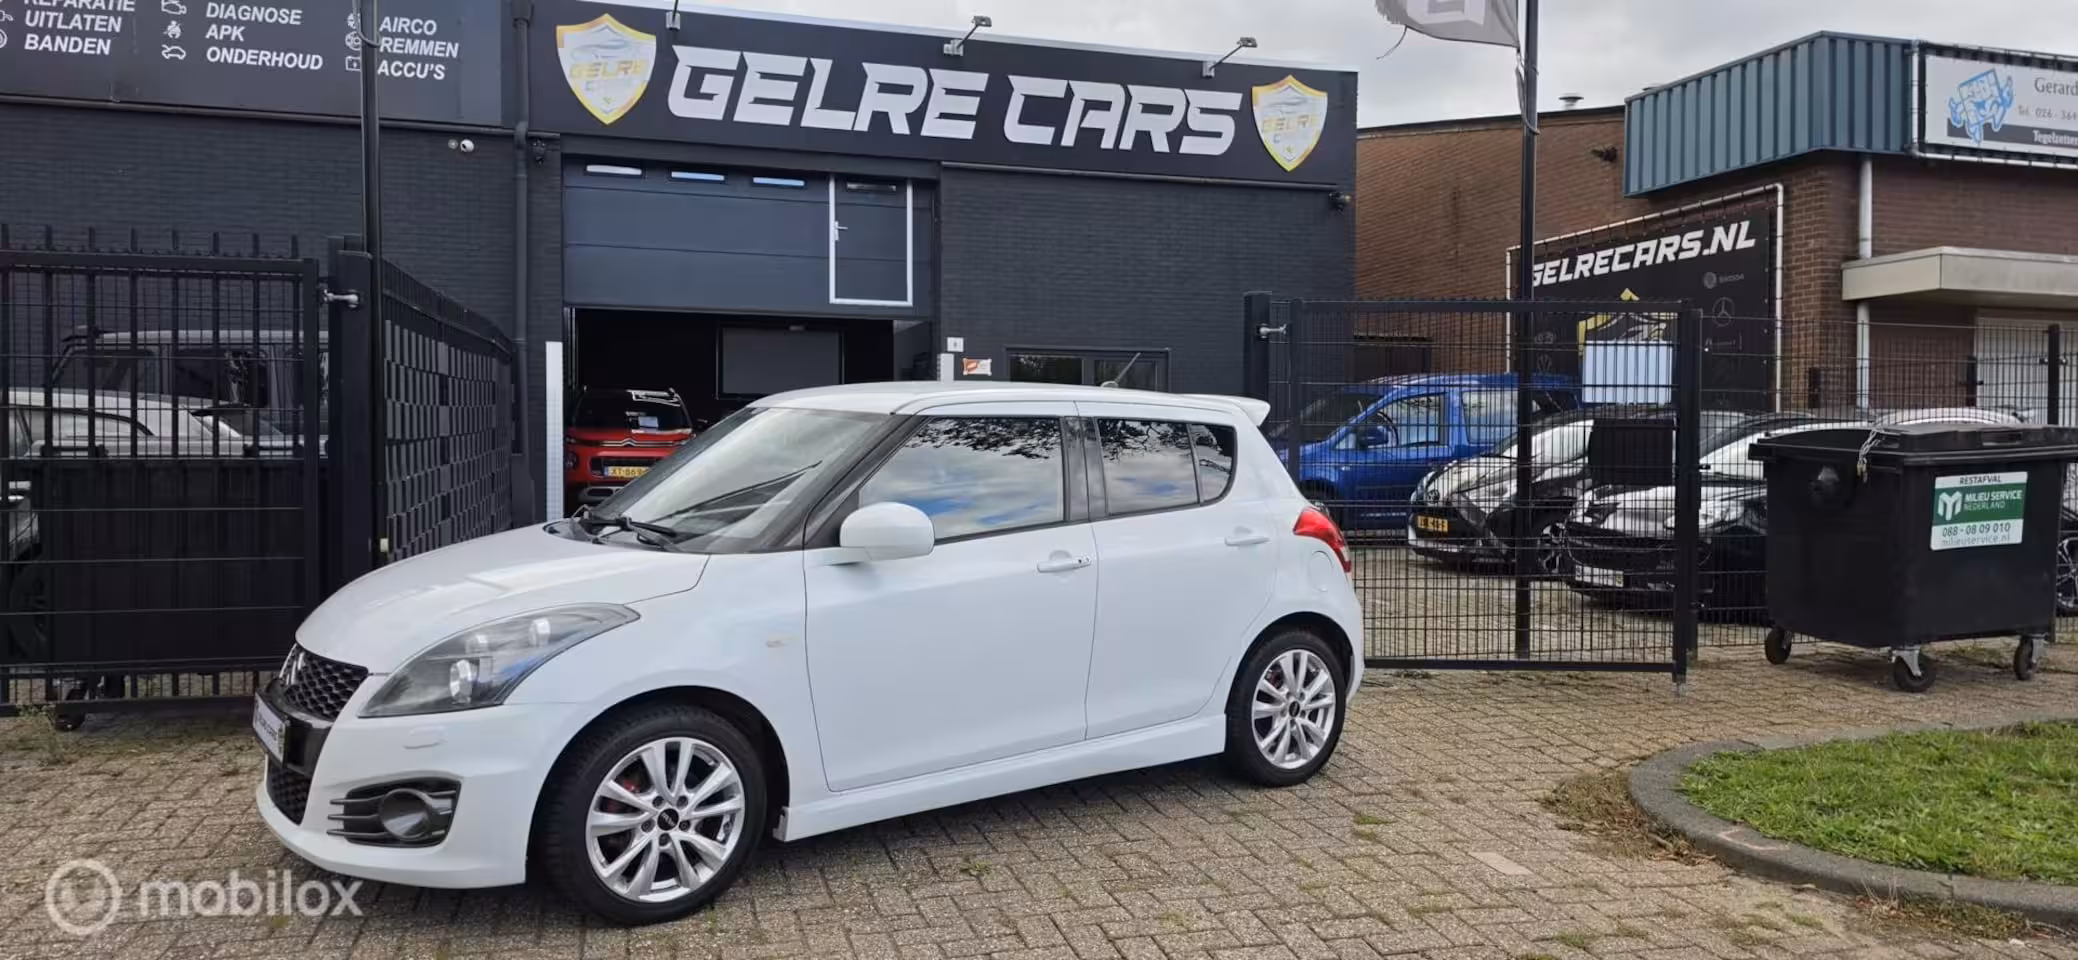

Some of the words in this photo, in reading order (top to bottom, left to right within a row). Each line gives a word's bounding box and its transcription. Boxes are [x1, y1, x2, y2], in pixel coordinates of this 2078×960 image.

[24, 0, 136, 12] RATIE
[206, 2, 303, 25] DIAGNOSE
[25, 9, 122, 32] UITLATEN
[379, 16, 437, 36] AIRCO
[205, 24, 245, 42] APK
[24, 33, 111, 55] BANDEN
[379, 37, 459, 58] REMMEN
[206, 46, 323, 70] ONDERHOUD
[377, 59, 446, 80] ACCU'S
[668, 45, 989, 140] GELRE
[1003, 75, 1243, 156] CARS
[1533, 220, 1756, 287] GELRECARS.NL
[1960, 475, 2001, 485] RESTAFVAL
[1964, 501, 2006, 511] NEDERLAND
[1965, 492, 1990, 502] MILIEU
[1991, 490, 2023, 501] SERVICE
[1942, 526, 1958, 537] 088
[1979, 523, 1990, 534] 09
[1993, 522, 2011, 533] 010
